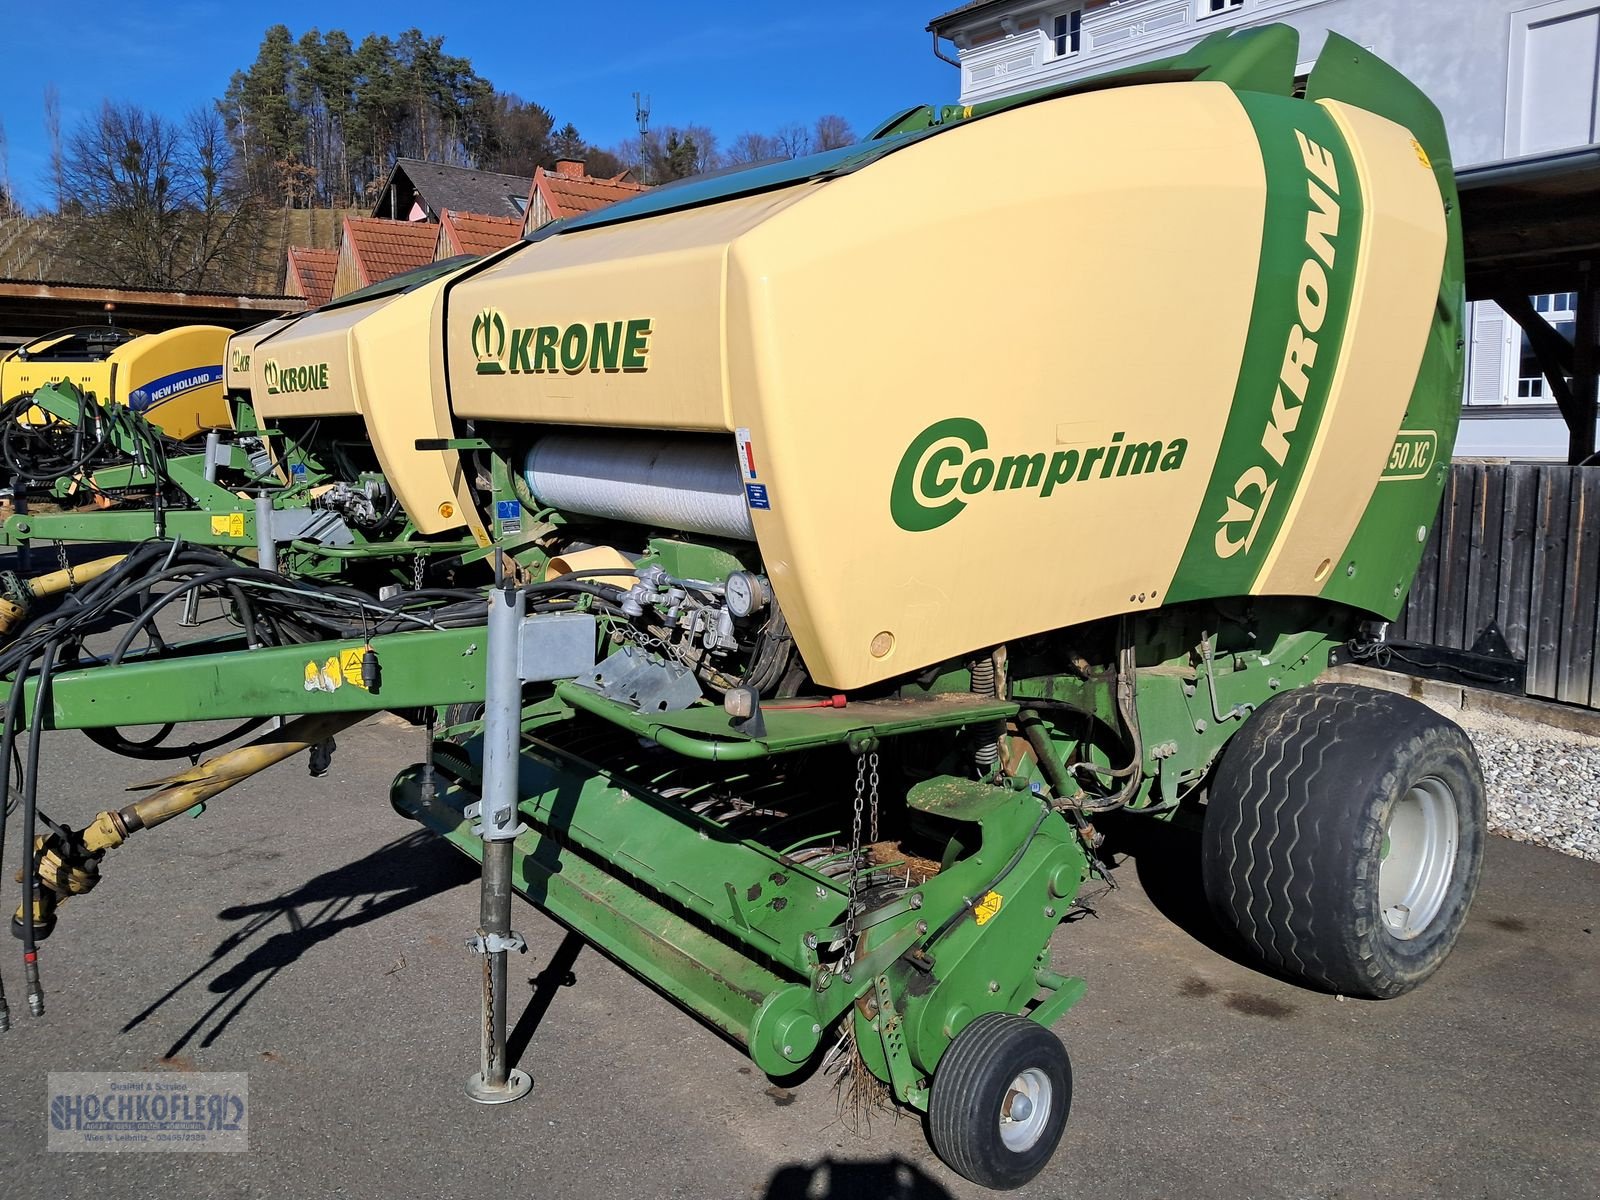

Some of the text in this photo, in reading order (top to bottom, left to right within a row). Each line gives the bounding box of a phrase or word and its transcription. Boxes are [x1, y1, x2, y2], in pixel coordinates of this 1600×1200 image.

[1261, 128, 1341, 467] KRONE
[509, 319, 652, 373] KRONE
[152, 373, 209, 402] NEW HOLLAND
[280, 363, 328, 393] KRONE
[890, 417, 1188, 532] Comprima
[1409, 441, 1430, 469] XC
